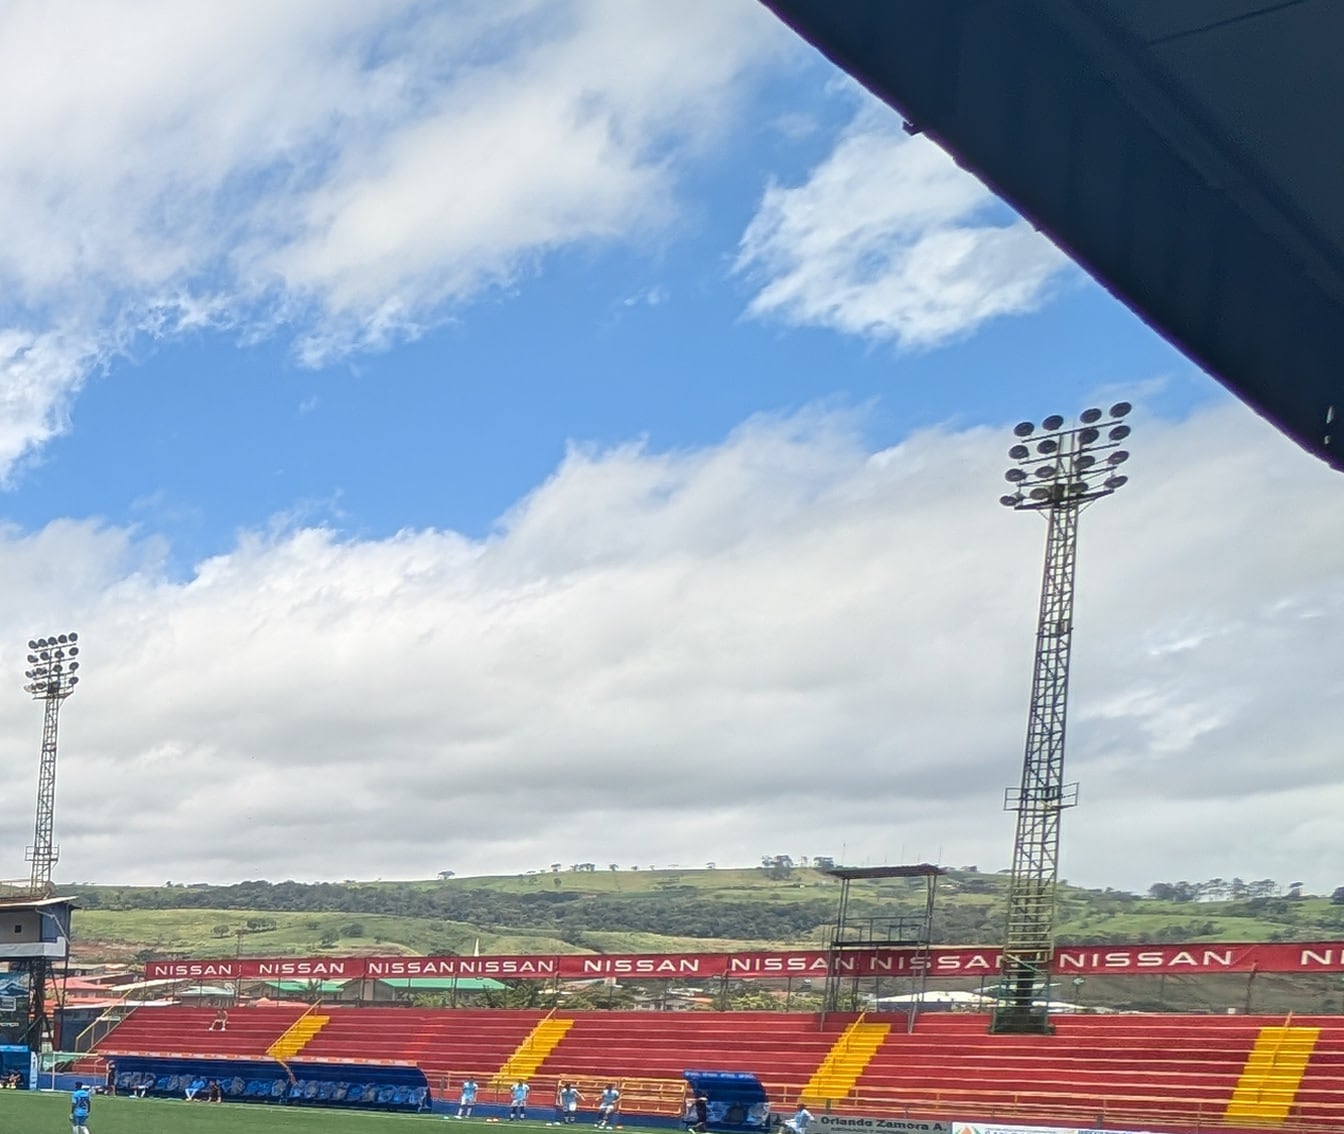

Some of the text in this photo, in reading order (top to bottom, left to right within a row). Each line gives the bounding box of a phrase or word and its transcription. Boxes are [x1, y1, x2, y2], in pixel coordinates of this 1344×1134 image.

[583, 959, 699, 972] NISSAN
[731, 957, 854, 971] NISSAN
[1059, 950, 1233, 968] NISSAN
[154, 964, 232, 976] NISSAN
[258, 963, 345, 974] NISSAN
[368, 961, 455, 974] NISSAN
[459, 960, 554, 973] NISSAN
[821, 1116, 947, 1131] Orlando Zamora A.
